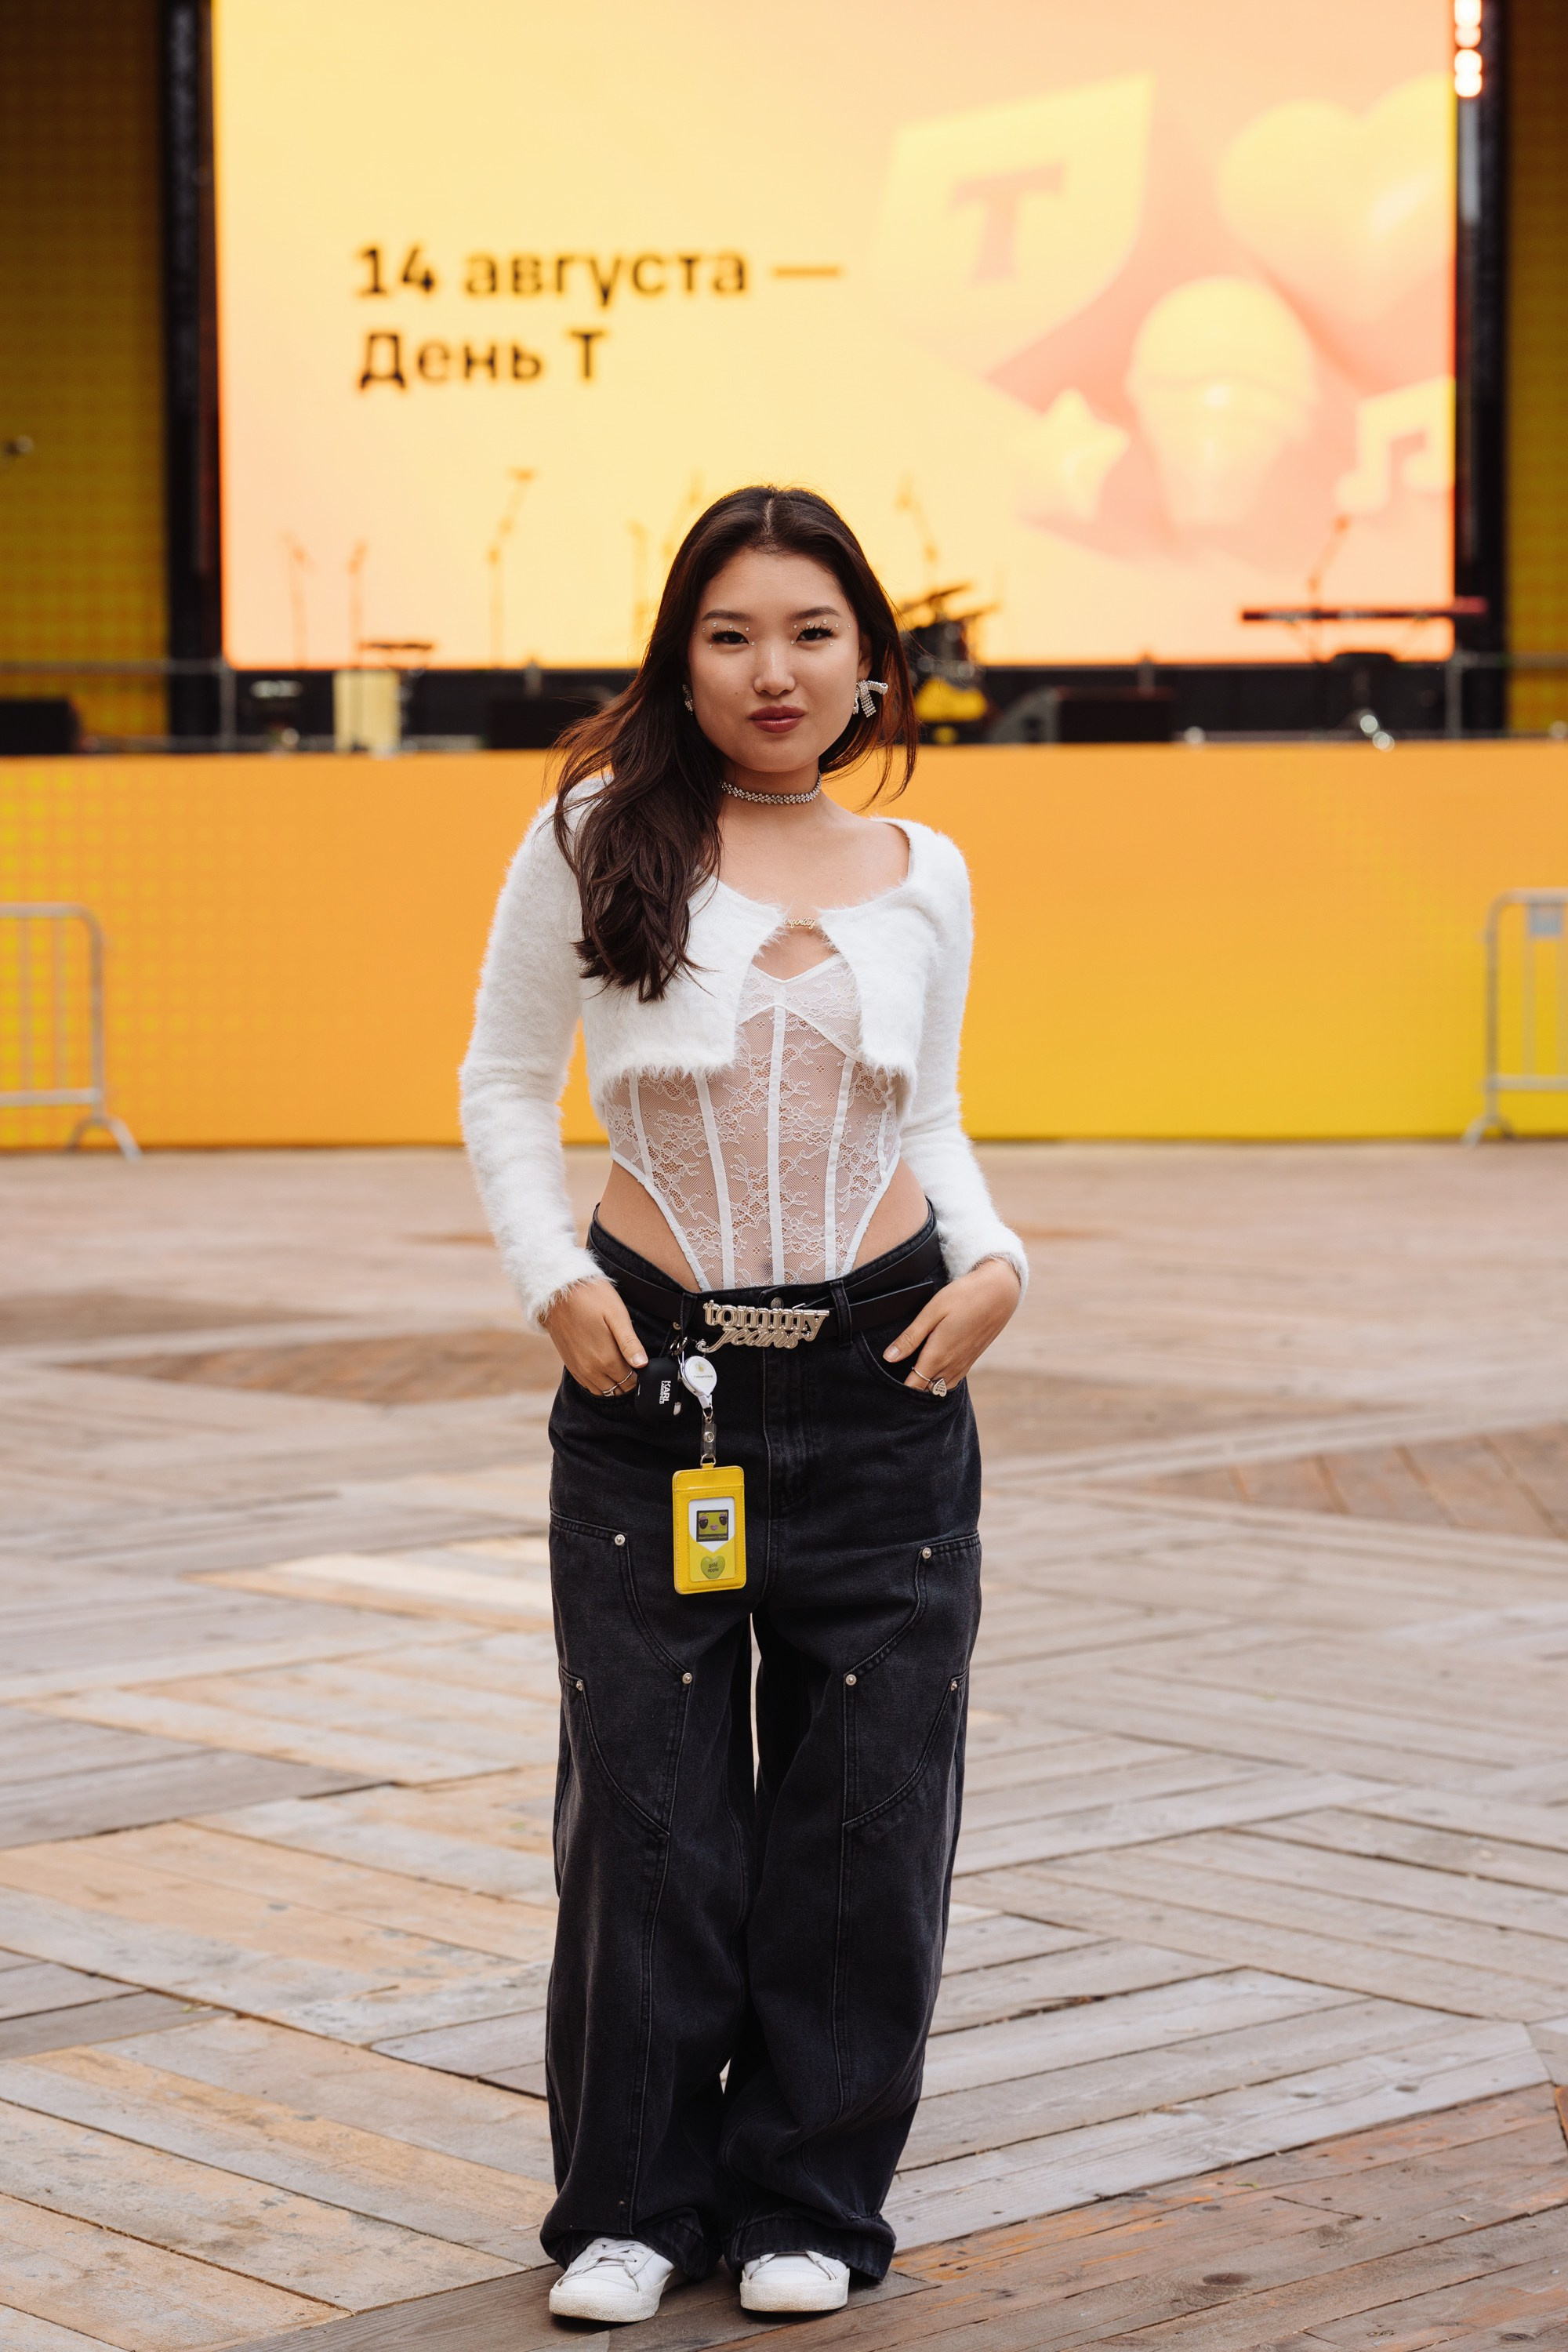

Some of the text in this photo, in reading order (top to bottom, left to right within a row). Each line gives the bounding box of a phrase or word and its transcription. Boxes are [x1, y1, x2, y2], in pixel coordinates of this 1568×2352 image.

[355, 243, 440, 299] 14
[462, 250, 750, 312] августа
[354, 326, 609, 394] День Т
[703, 1300, 829, 1341] tommy
